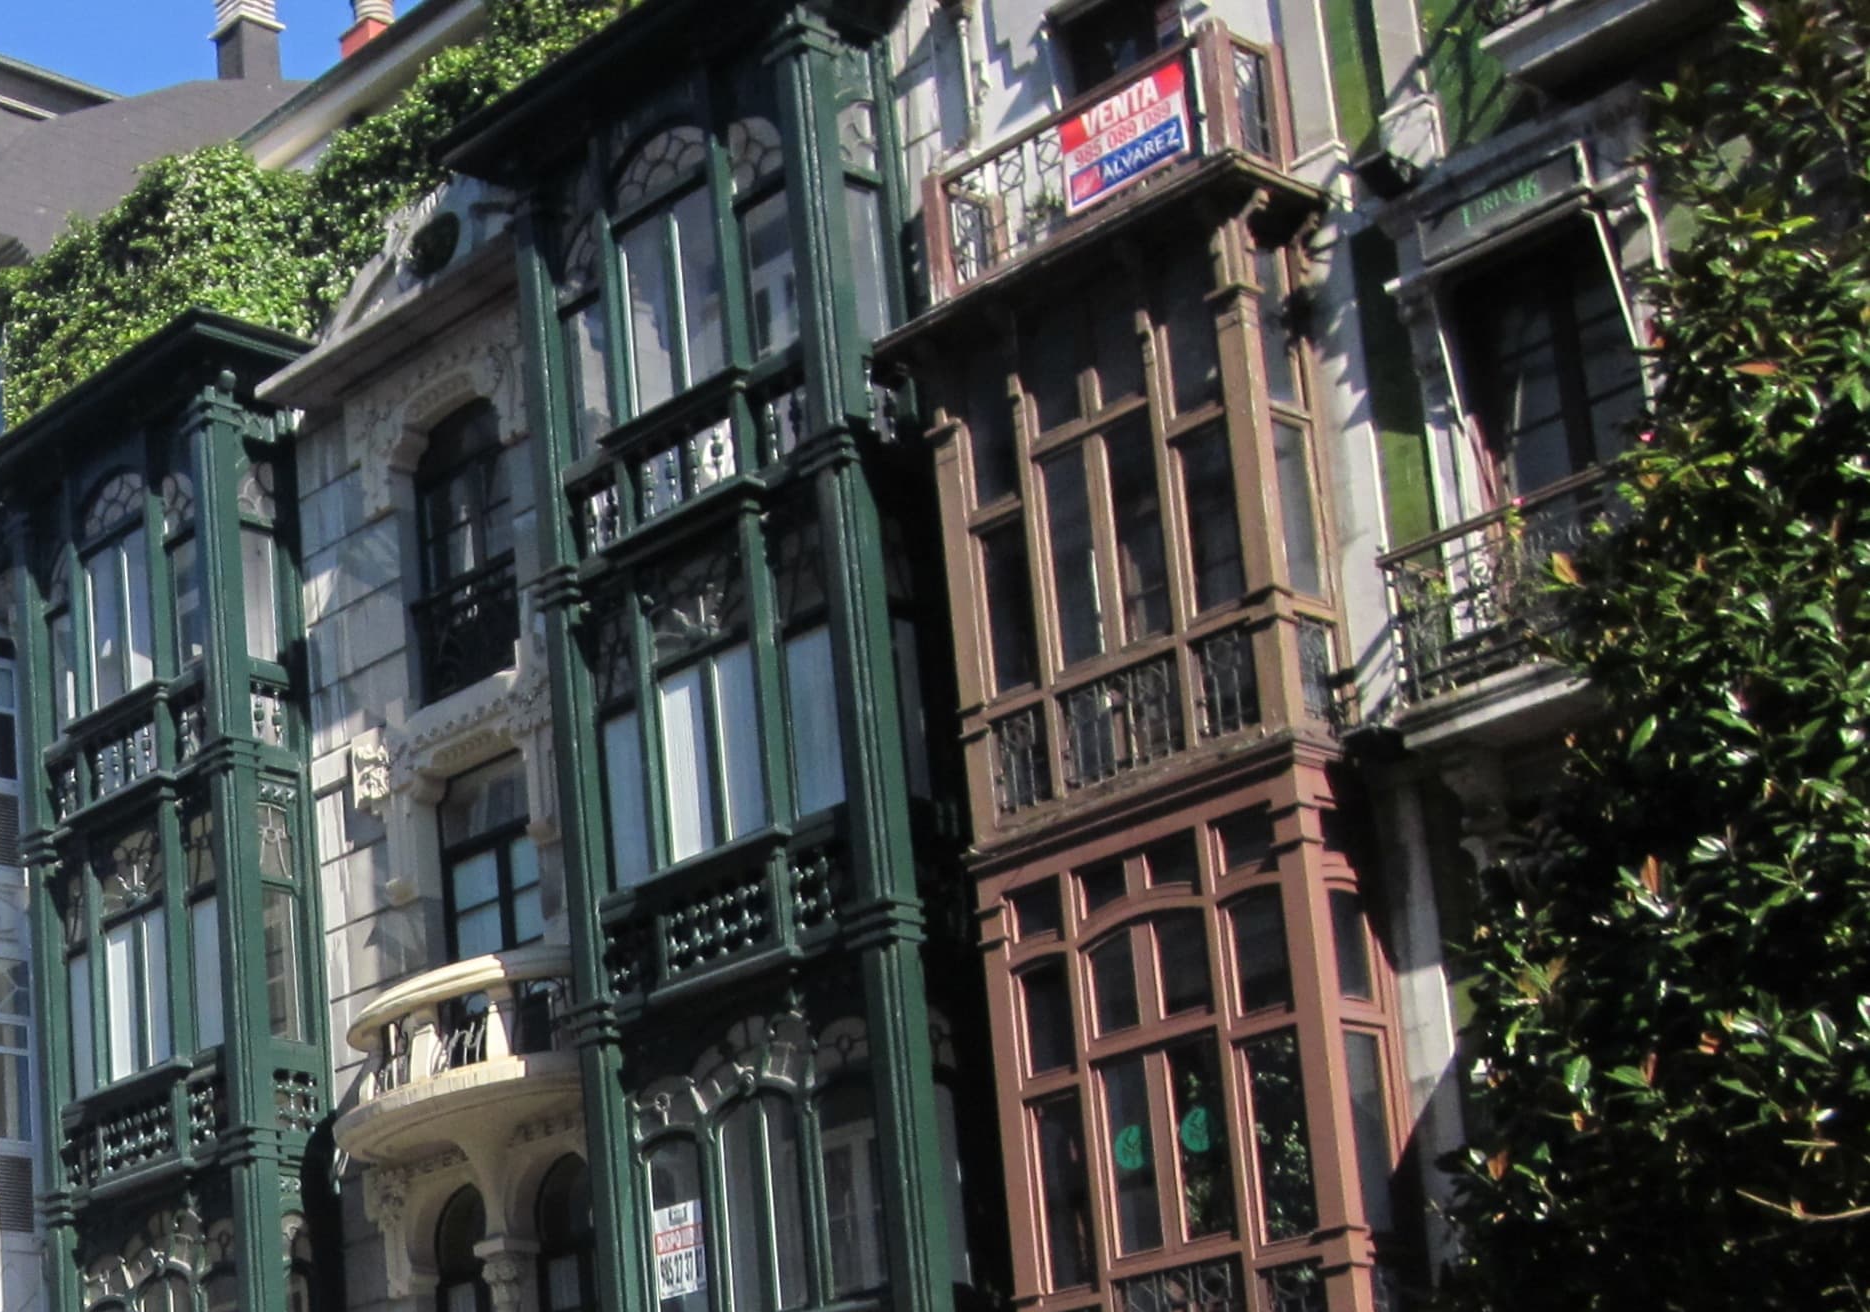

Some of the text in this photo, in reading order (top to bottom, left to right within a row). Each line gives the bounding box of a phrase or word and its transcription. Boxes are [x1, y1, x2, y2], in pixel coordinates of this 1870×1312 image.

[1080, 75, 1161, 139] VENTA
[1073, 138, 1103, 169] 985
[1107, 121, 1138, 149] 089
